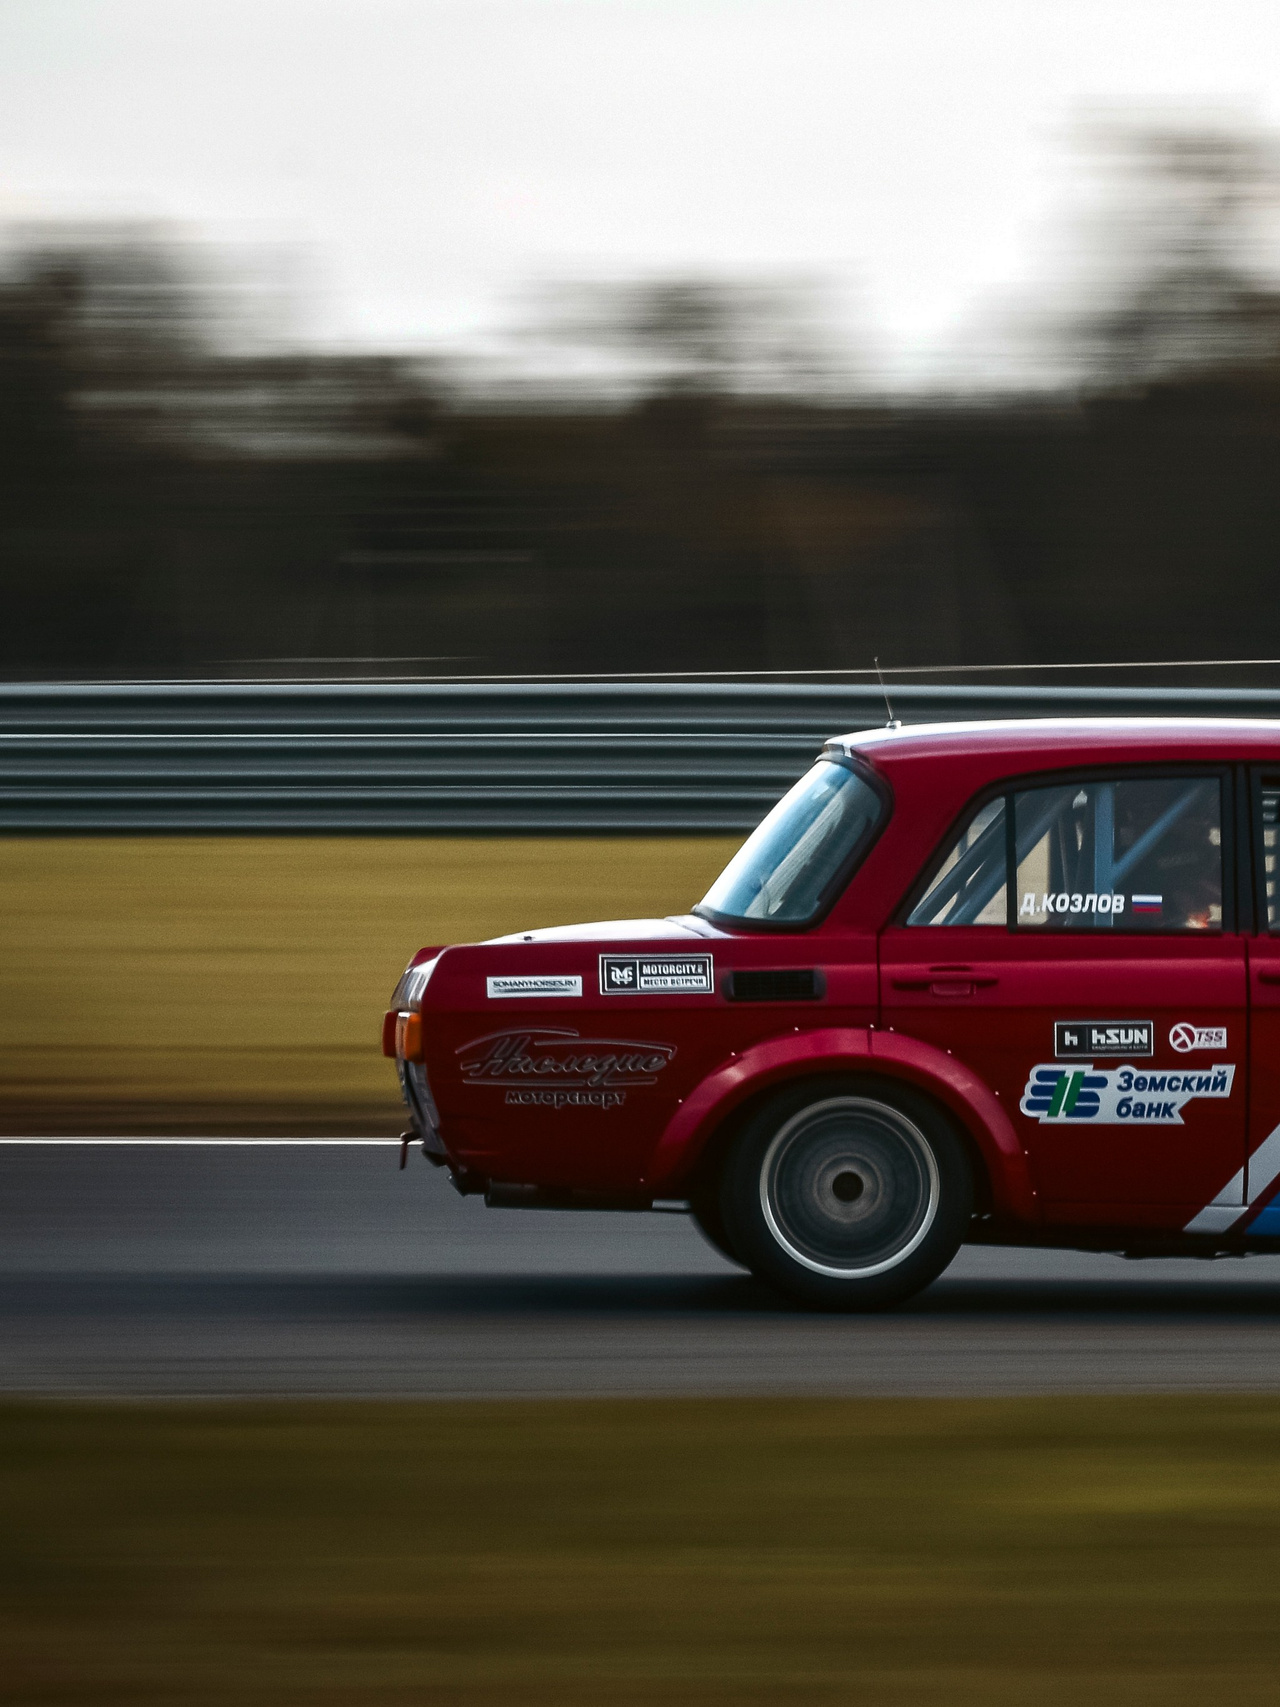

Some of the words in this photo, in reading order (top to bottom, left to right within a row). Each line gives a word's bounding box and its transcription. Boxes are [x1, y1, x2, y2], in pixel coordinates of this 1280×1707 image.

[1020, 893, 1125, 915] Д.КОЗЛОВ
[1196, 1030, 1223, 1043] TSS
[461, 1036, 668, 1087] Наследие
[1116, 1071, 1228, 1092] Земский
[1116, 1096, 1178, 1118] банк
